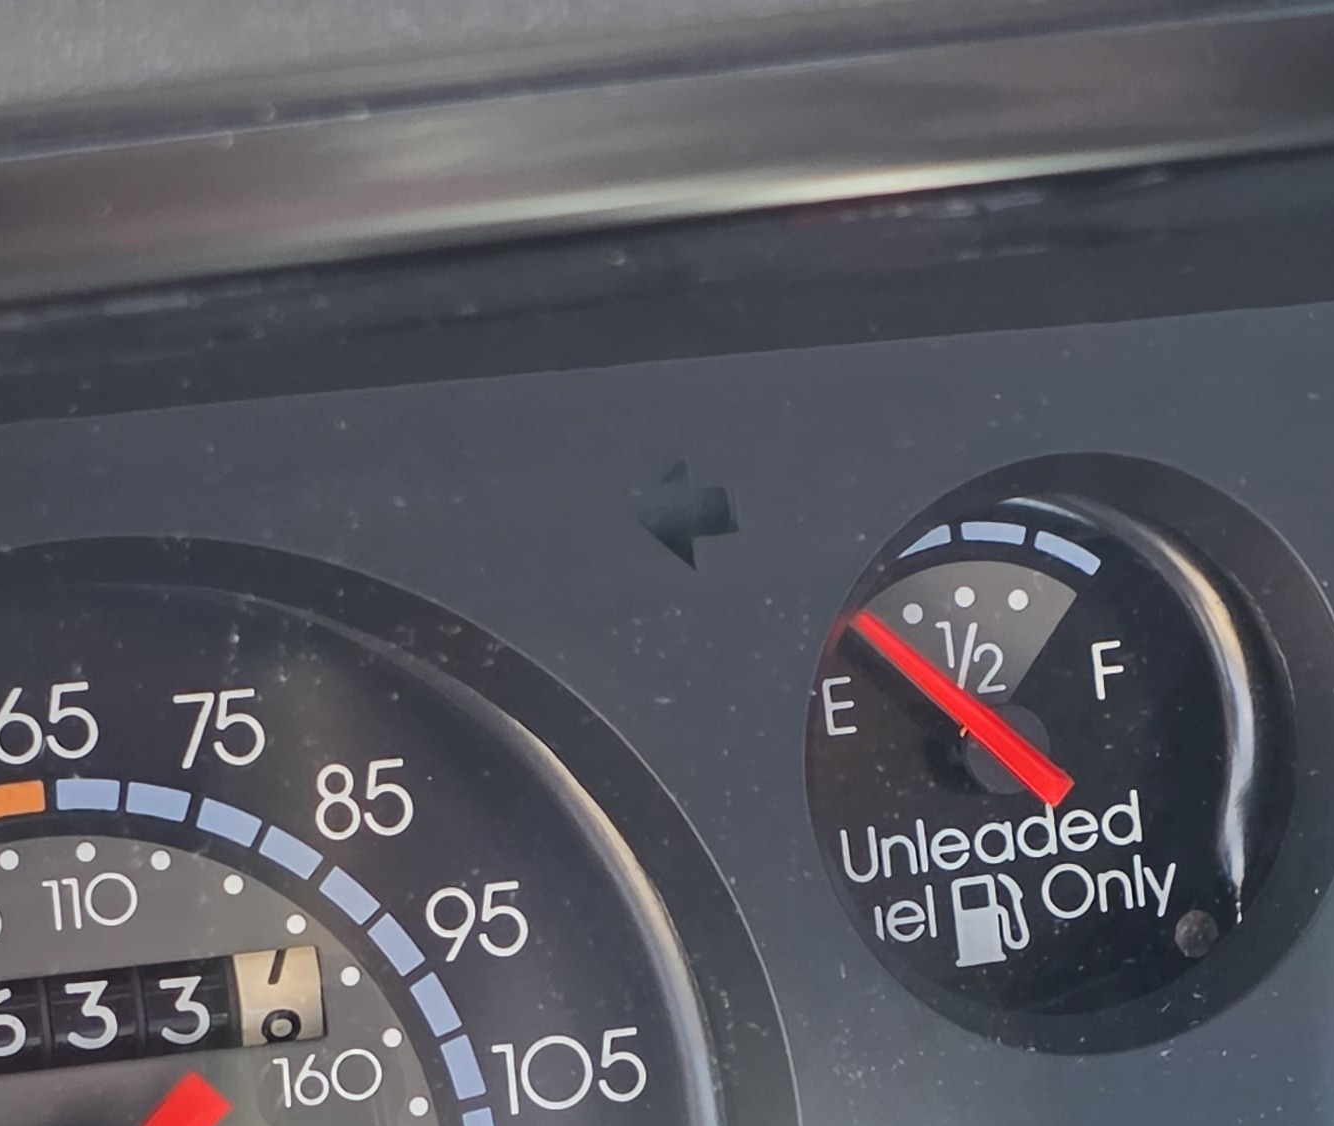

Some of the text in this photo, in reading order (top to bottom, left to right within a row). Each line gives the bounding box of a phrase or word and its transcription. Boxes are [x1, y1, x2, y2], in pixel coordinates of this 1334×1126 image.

[821, 676, 858, 736] E
[1091, 640, 1125, 701] F
[172, 688, 266, 769] 75
[314, 757, 415, 841] 85
[839, 789, 1144, 884] Unleaded
[41, 871, 139, 933] 110
[424, 880, 530, 963] 95
[1040, 854, 1177, 918] Only
[272, 1048, 383, 1109] 160
[491, 1027, 648, 1116] 105
